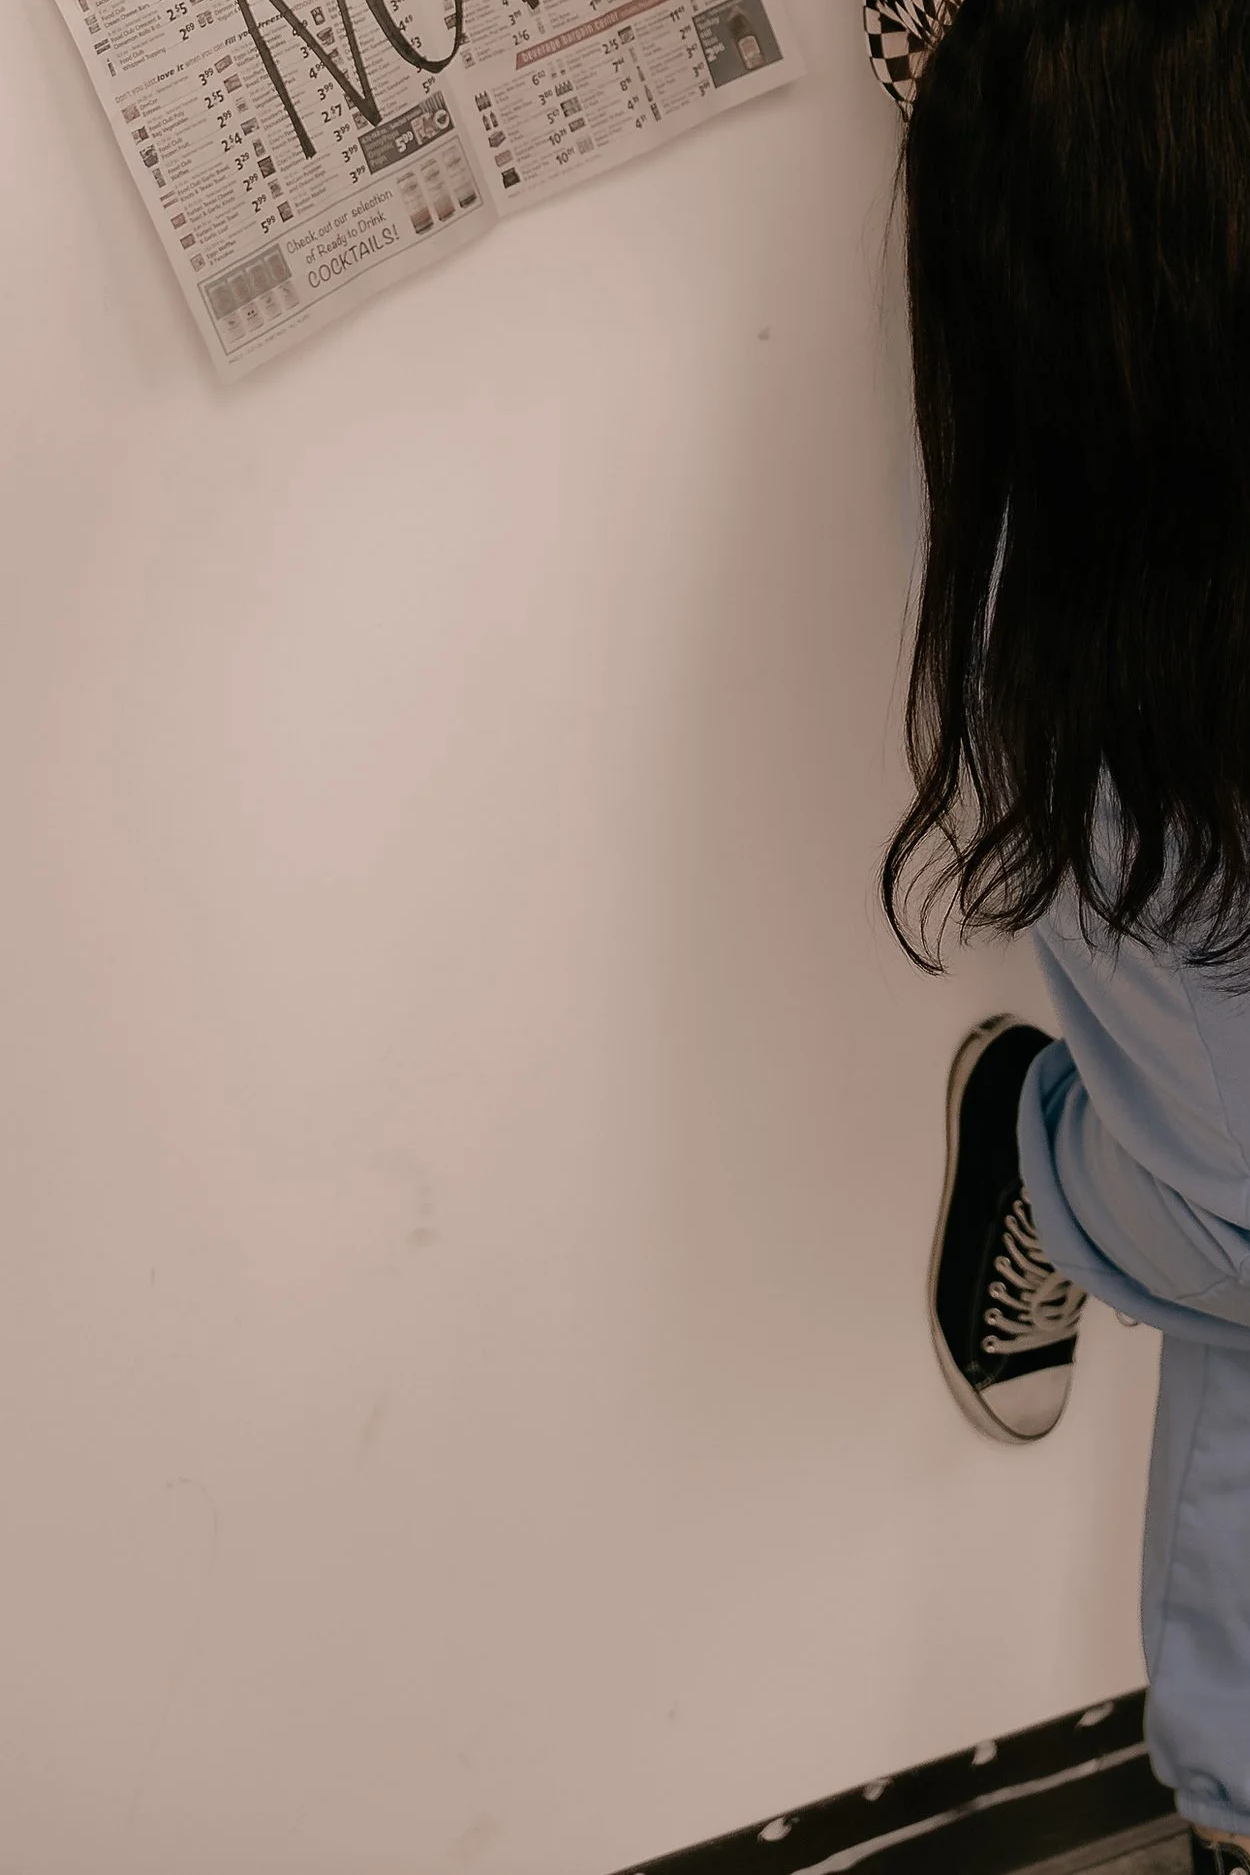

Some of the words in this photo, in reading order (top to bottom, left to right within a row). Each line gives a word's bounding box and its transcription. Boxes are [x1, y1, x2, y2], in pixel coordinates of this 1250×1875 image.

[156, 66, 176, 82] love
[175, 61, 185, 71] it
[223, 35, 236, 47] fill
[285, 227, 318, 254] Check
[316, 220, 333, 237] out
[333, 212, 350, 228] our
[349, 185, 393, 218] selection
[303, 247, 317, 264] of
[316, 231, 348, 259] Ready
[346, 224, 358, 239] to
[357, 208, 386, 233] Drink
[306, 223, 399, 288] COCKTAILS!
